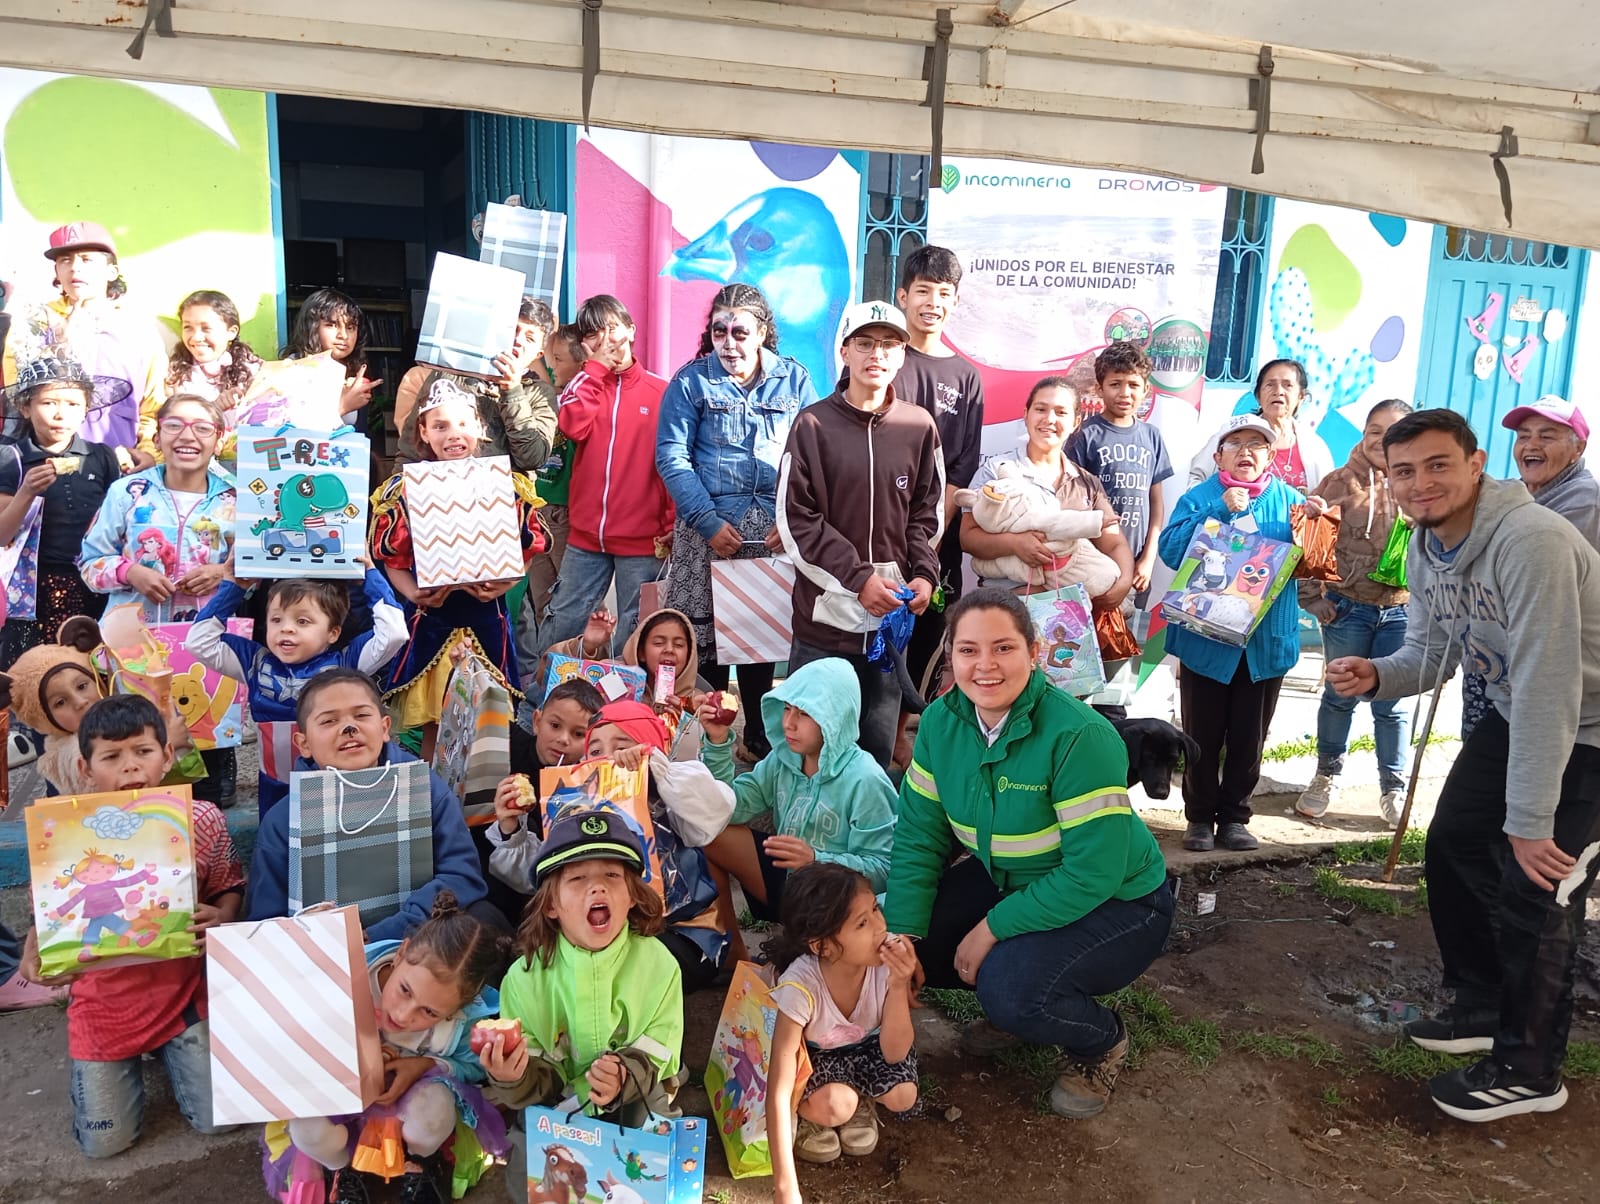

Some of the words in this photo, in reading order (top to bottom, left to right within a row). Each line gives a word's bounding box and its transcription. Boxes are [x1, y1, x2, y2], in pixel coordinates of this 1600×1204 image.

[1099, 178, 1194, 192] DROMOS
[970, 259, 1031, 273] ¡UNIDOS
[1035, 260, 1066, 273] POR
[1070, 261, 1088, 274] EL
[1092, 262, 1175, 276] BIENESTAR
[996, 274, 1016, 287] DE
[1020, 275, 1039, 287] LA
[1043, 275, 1137, 290] COMUNIDAD!
[1097, 443, 1151, 468] ROCK
[1098, 473, 1111, 483] ND
[1114, 472, 1147, 491] ROLL
[1106, 495, 1144, 506] NCERT
[1119, 511, 1140, 528] 85
[538, 1116, 550, 1133] A
